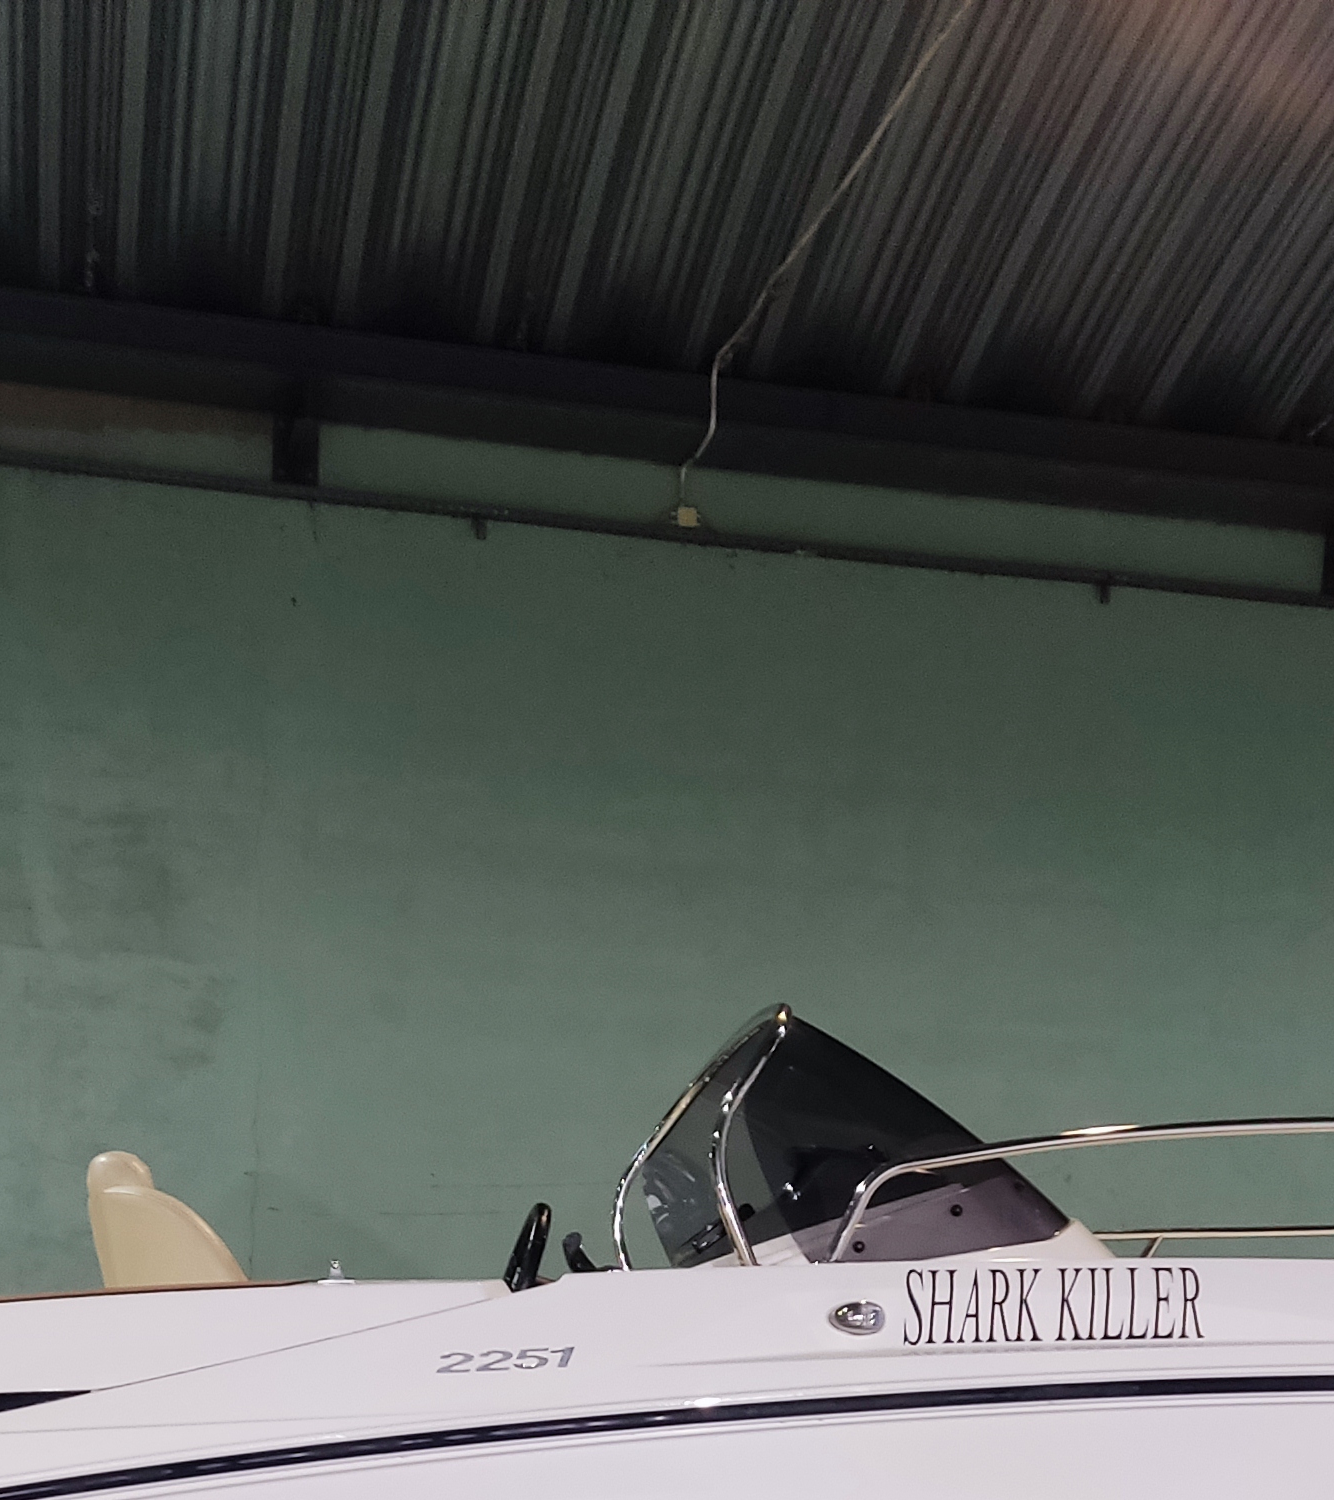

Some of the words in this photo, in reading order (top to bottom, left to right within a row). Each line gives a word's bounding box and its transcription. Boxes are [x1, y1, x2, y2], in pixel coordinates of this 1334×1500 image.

[902, 1268, 1044, 1346] SHARK
[1054, 1267, 1206, 1341] KILLER
[435, 1345, 575, 1374] 2251
